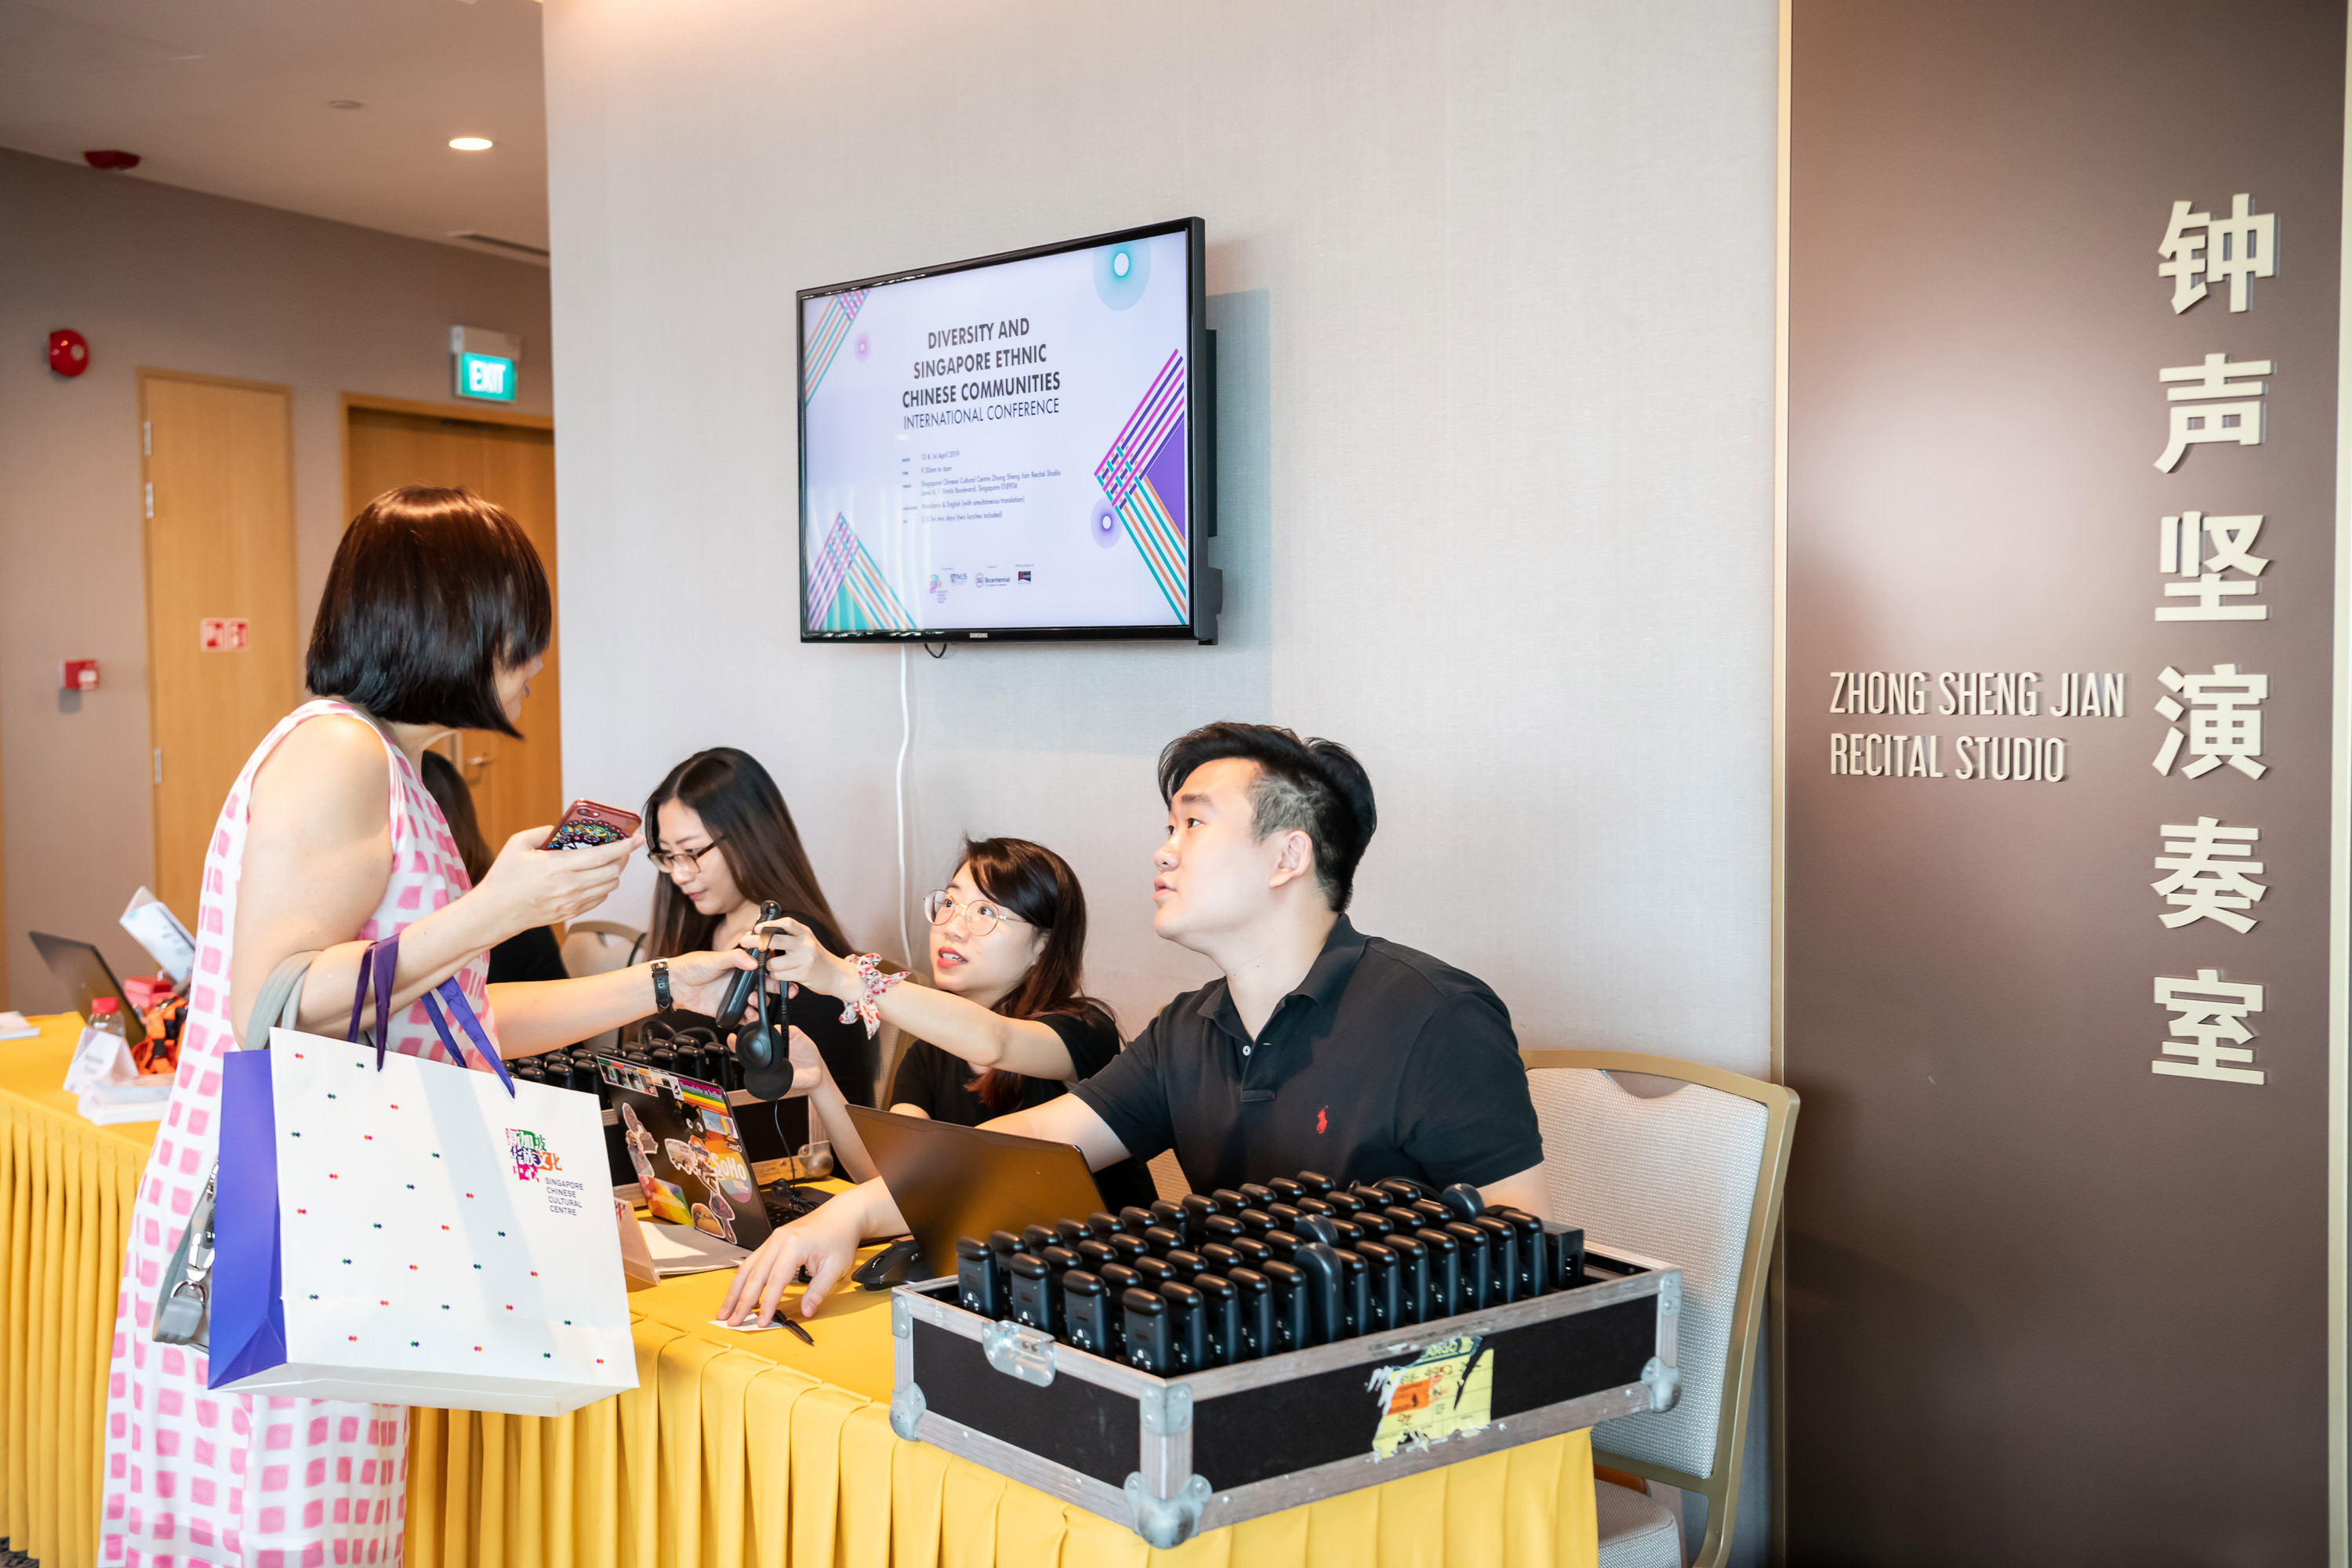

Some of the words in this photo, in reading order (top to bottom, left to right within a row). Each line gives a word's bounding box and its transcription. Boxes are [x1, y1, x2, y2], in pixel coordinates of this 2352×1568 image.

[928, 322, 994, 349] DIVERSITY
[998, 318, 1029, 339] AND
[914, 352, 991, 379] SINGAPORE
[996, 343, 1047, 368] ETHNIC
[470, 360, 506, 394] EXIT
[902, 385, 956, 408] CHINESE
[961, 371, 1061, 401] COMMUNITIES
[904, 407, 984, 430] INTERNATIONAL
[987, 398, 1059, 420] CONFERENCE
[947, 500, 961, 509] English
[1000, 495, 1025, 504] translation)
[983, 510, 1003, 520] included)
[956, 572, 967, 581] NUS
[2151, 193, 2275, 1085] 钟声坚演奏室
[1830, 671, 1926, 715] ZHONG
[1938, 671, 2038, 716] SHENG
[2049, 672, 2125, 717] JIAN
[1831, 733, 1944, 779] RECITAL
[1955, 735, 2065, 782] STUDIO
[510, 1145, 562, 1171] 华族文化
[711, 1152, 748, 1181] SoHo
[545, 1177, 583, 1190] SINGAPORE
[546, 1186, 576, 1198] CHINESE
[548, 1196, 583, 1208] CULTURAL
[550, 1204, 577, 1216] CENTRE
